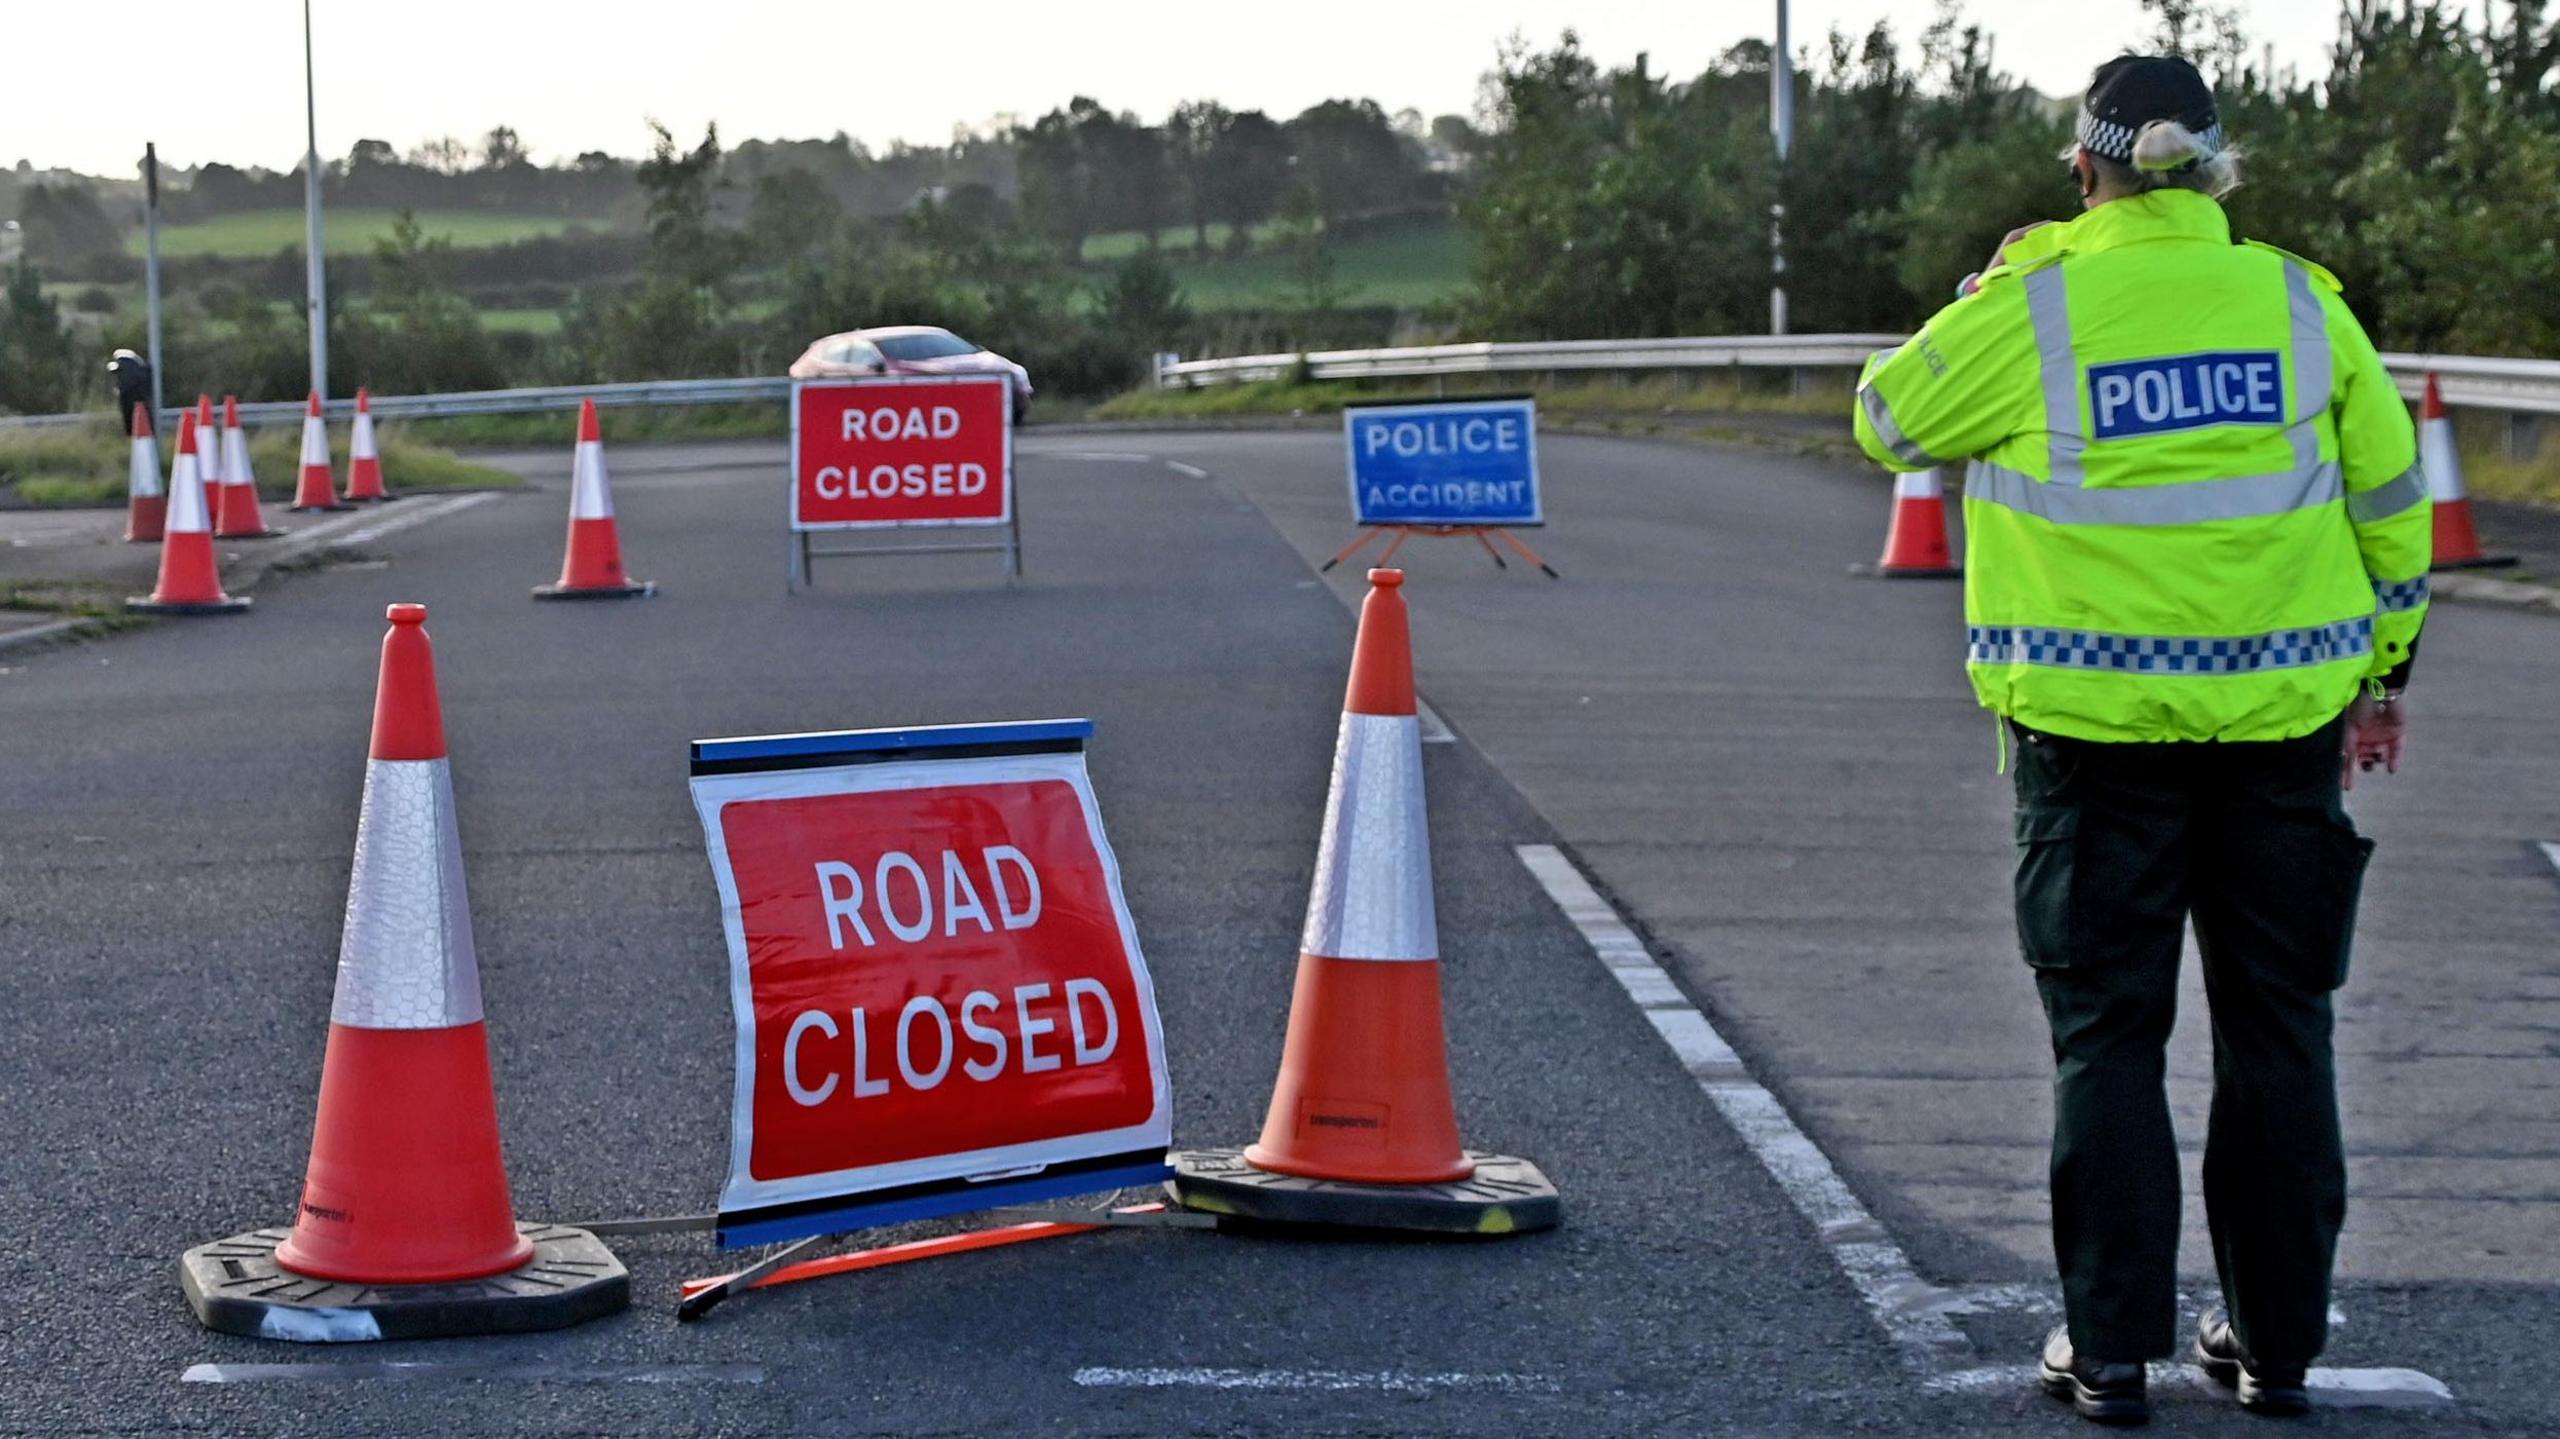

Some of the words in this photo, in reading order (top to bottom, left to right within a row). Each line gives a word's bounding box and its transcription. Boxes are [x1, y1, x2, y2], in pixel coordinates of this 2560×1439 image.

[1918, 335, 1949, 378] LICE
[2097, 362, 2277, 428] POLICE
[842, 405, 961, 442] ROAD
[1366, 417, 1519, 458] POLICE
[815, 462, 988, 501] CLOSED
[1367, 479, 1526, 508] ACCIDENT
[814, 844, 1042, 950] ROAD
[783, 977, 1119, 1107] CLOSED
